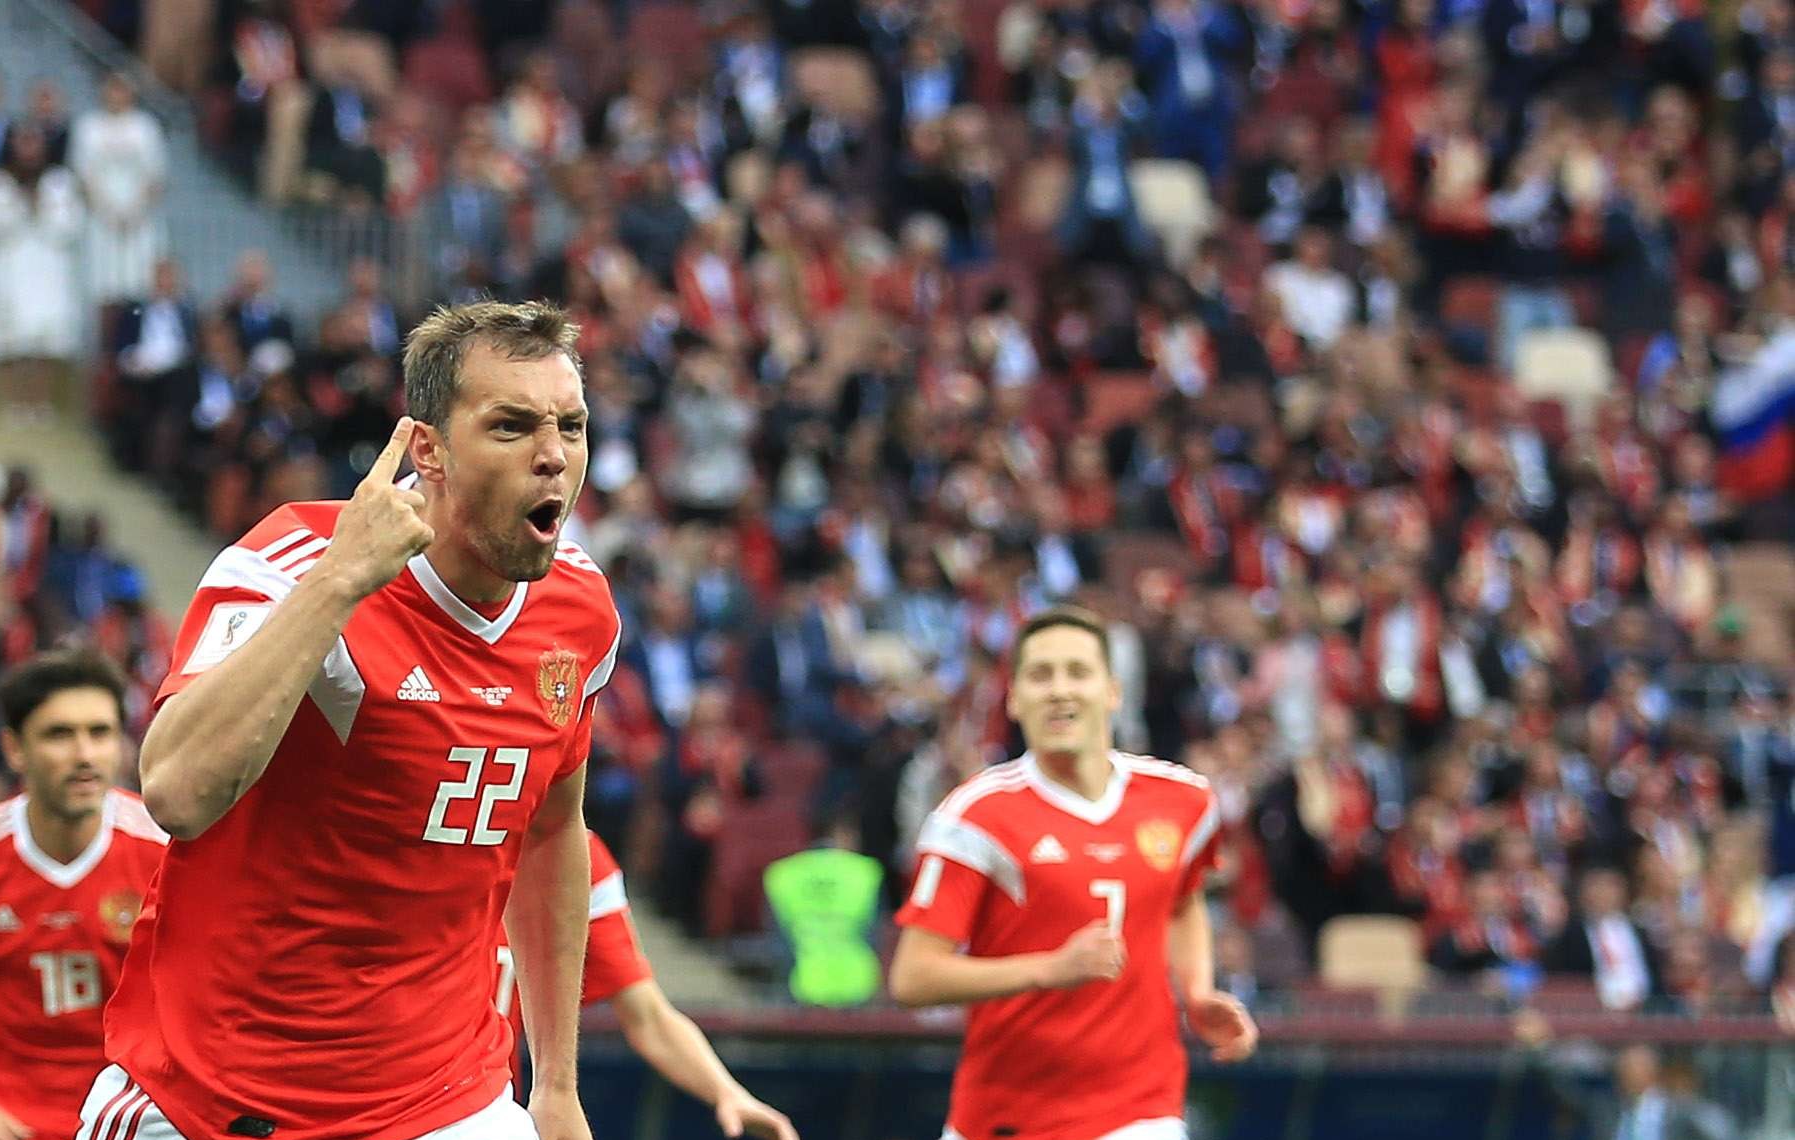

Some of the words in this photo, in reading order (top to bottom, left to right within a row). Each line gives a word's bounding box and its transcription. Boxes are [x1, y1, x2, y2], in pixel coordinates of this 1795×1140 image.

[397, 687, 441, 702] adidas
[423, 747, 529, 845] 22
[30, 951, 102, 1016] 18
